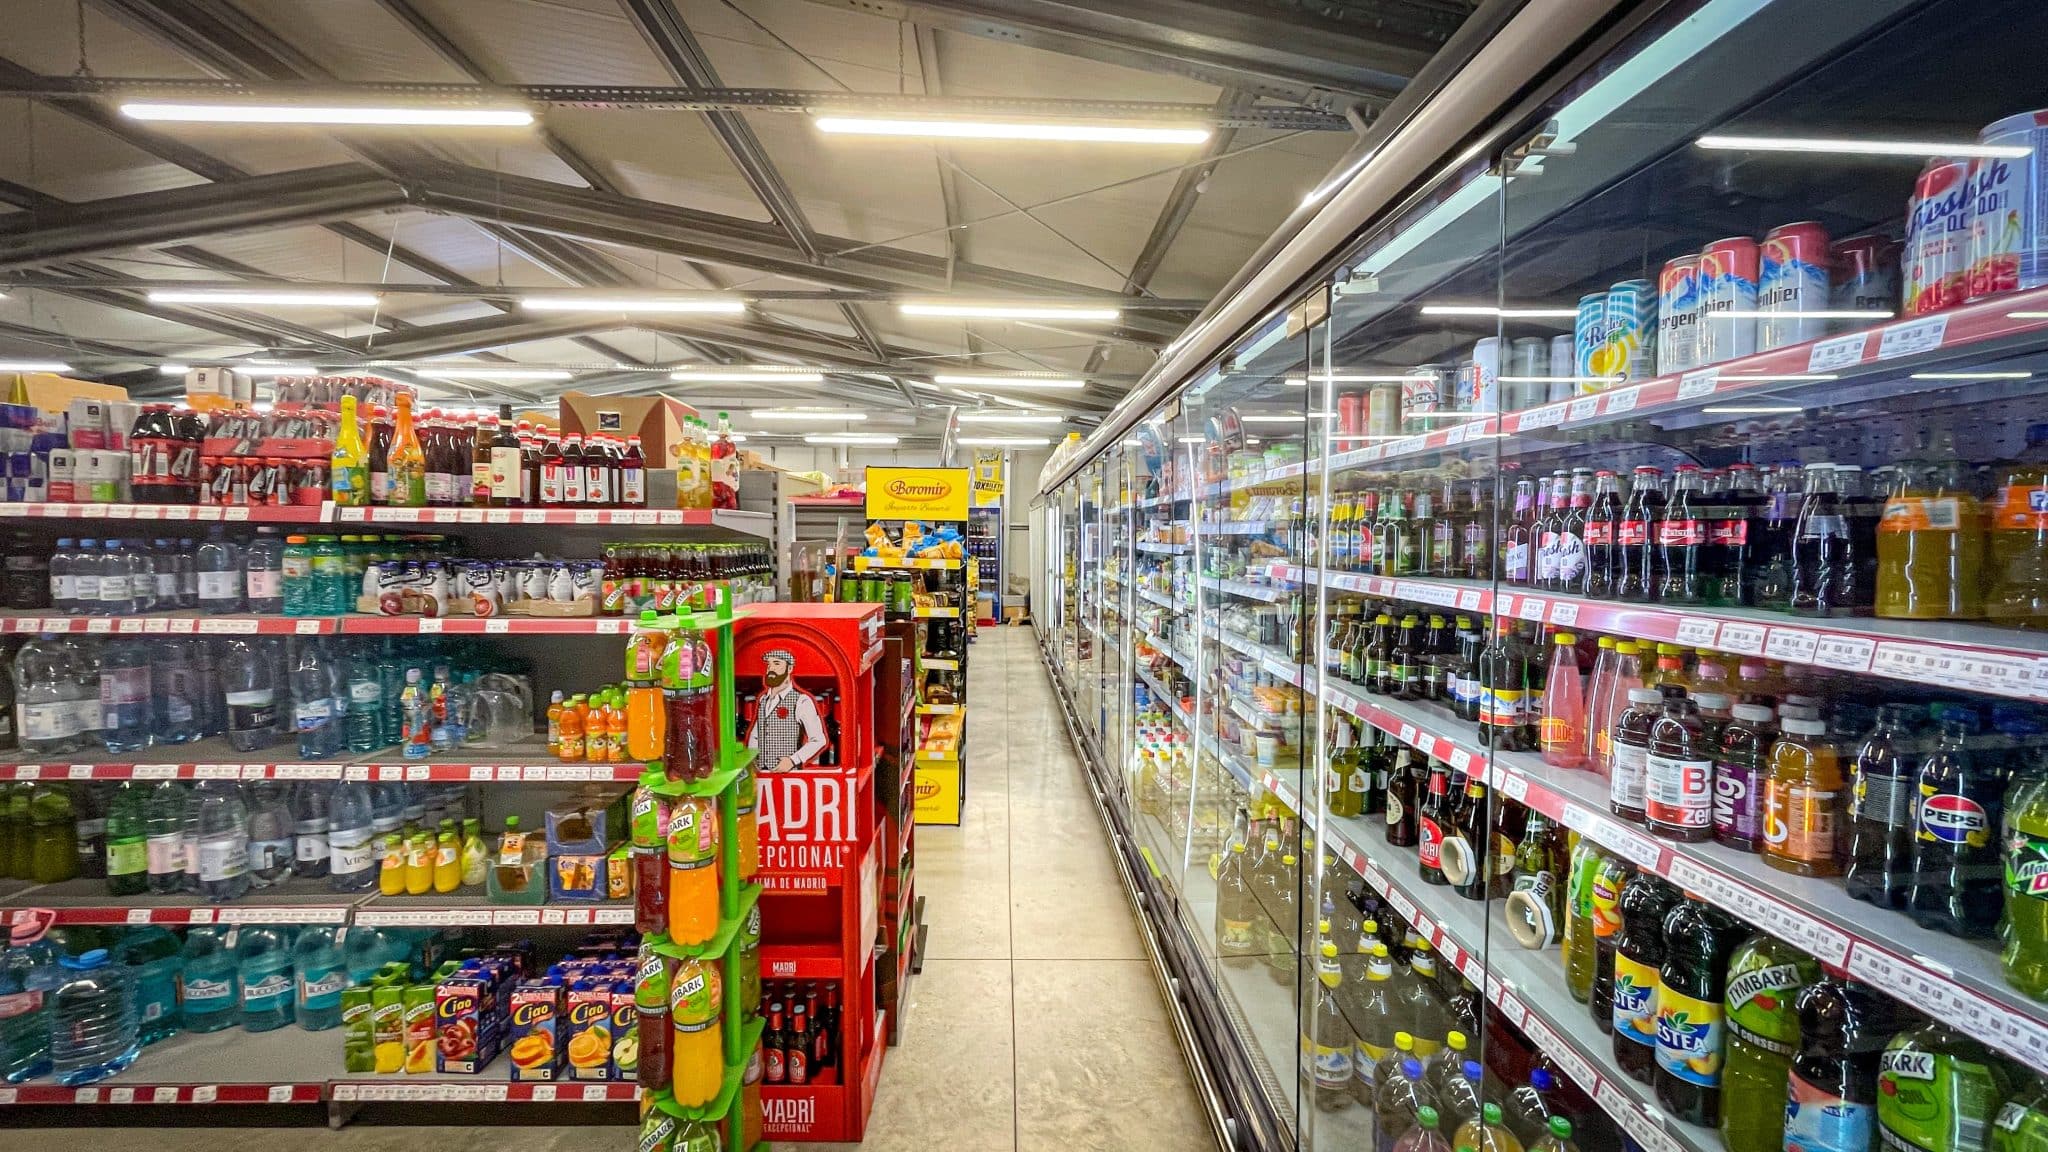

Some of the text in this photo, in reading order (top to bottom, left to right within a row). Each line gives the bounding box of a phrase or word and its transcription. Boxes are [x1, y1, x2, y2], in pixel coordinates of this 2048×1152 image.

[889, 480, 946, 496] Boromir
[1924, 807, 1984, 828] PEPSI
[780, 877, 790, 890] DE
[793, 877, 828, 890] MADRID
[1728, 967, 1799, 1005] TYMBARK
[440, 995, 472, 1019] Ciao
[513, 1002, 549, 1027] Ciao
[570, 1001, 604, 1026] Ciao
